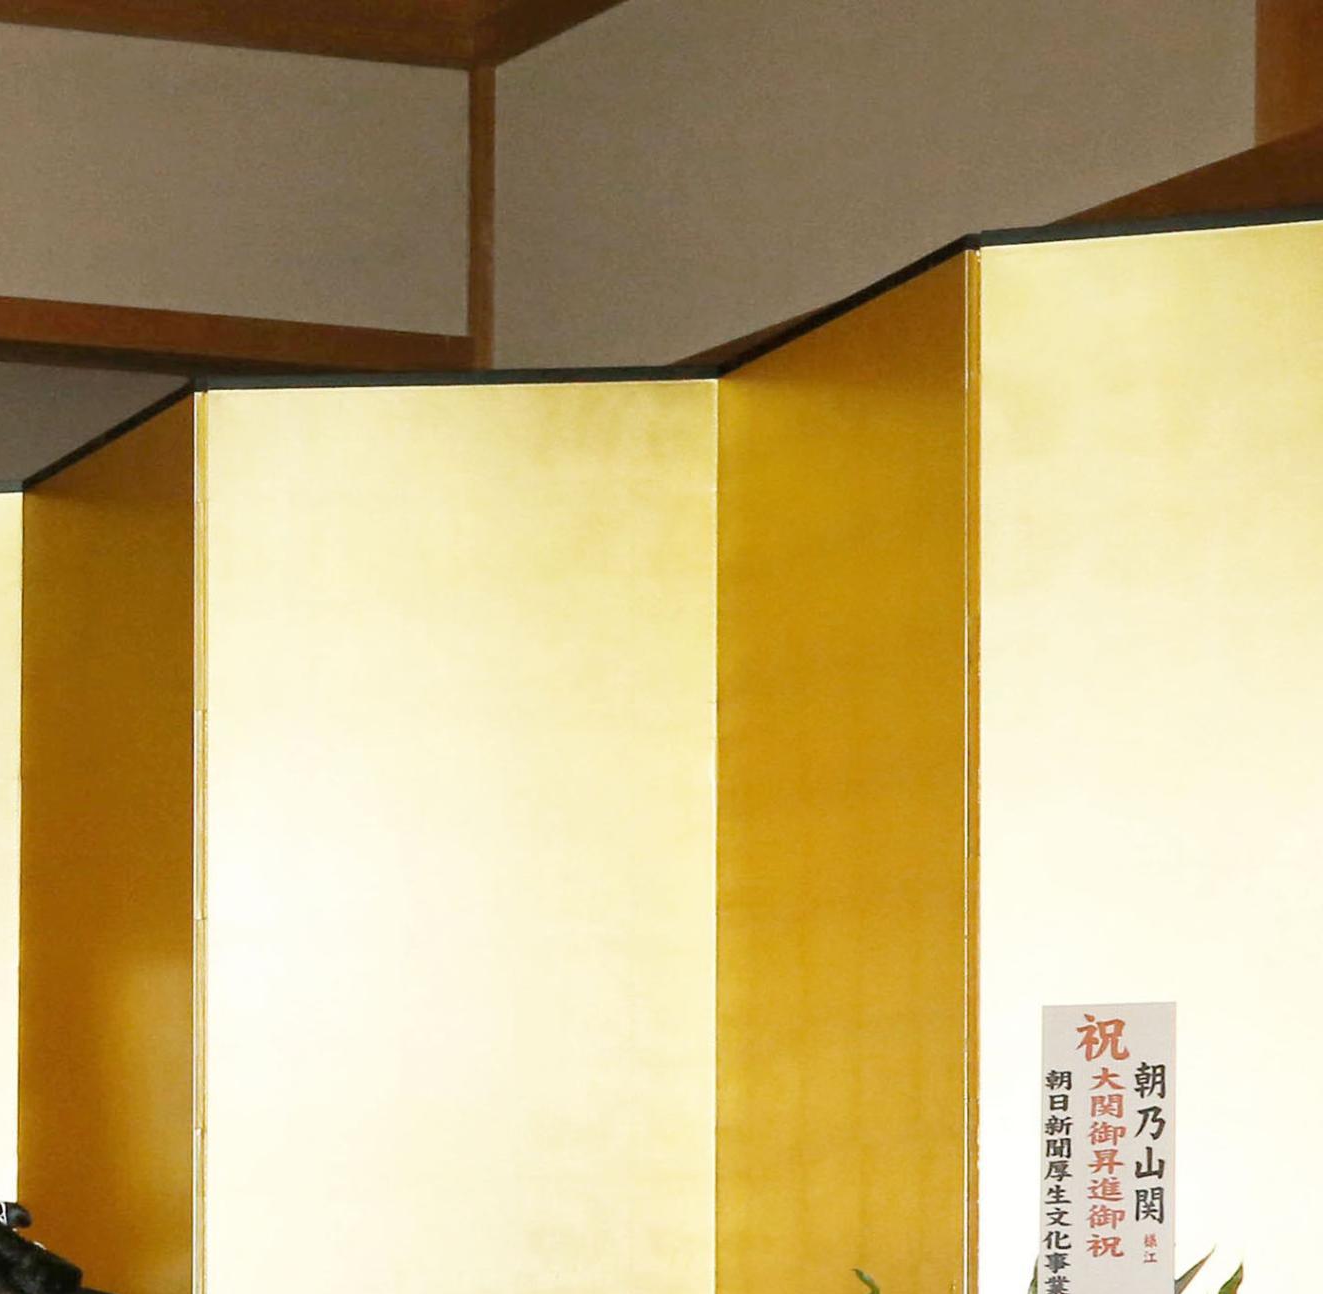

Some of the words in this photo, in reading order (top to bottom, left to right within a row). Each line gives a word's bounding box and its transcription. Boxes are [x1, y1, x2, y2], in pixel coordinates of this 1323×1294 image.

[1075, 1012, 1131, 1062] 祝
[1086, 1067, 1127, 1259] 大関御昇進御祝
[1133, 1061, 1167, 1225] 朝乃山関
